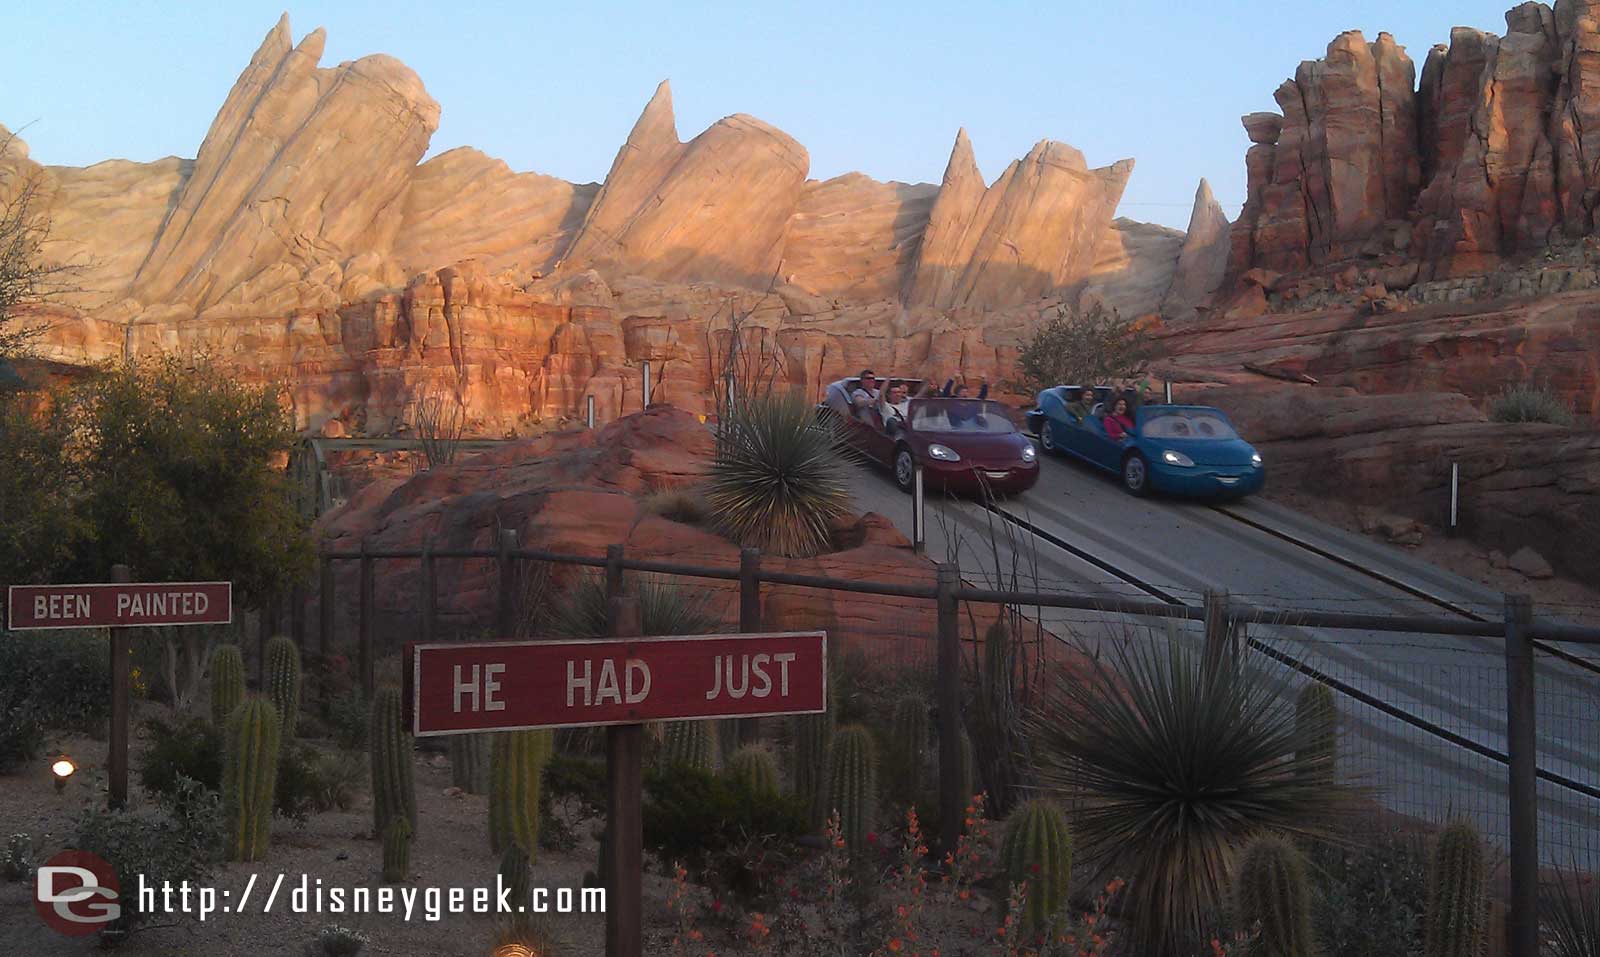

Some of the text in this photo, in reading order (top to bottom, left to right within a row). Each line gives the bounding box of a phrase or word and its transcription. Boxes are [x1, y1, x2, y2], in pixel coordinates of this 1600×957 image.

[34, 592, 209, 619] BEEN PAINTED
[453, 653, 796, 712] HE HAD JUST
